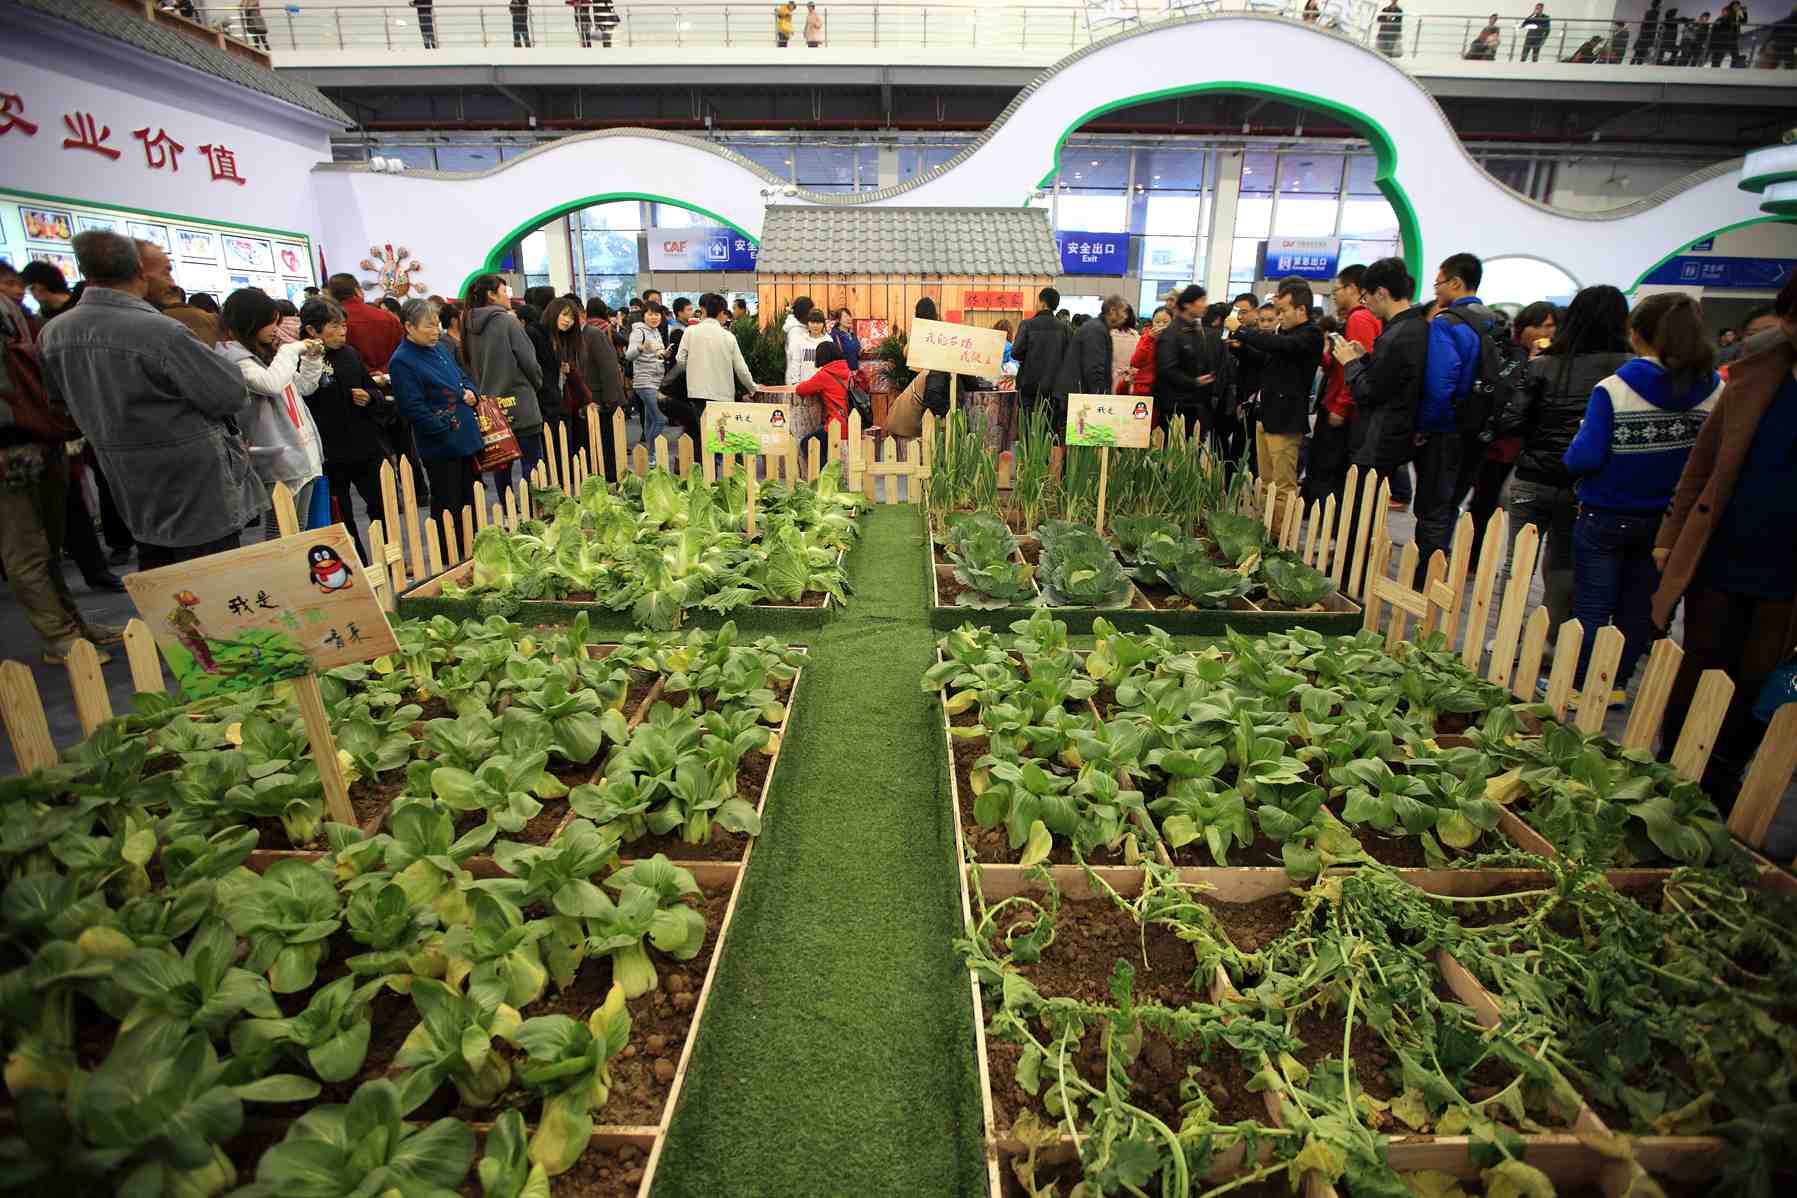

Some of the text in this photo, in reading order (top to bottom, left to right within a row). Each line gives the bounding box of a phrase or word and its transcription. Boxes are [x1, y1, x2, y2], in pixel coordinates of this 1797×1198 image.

[663, 240, 688, 252] CAF
[1067, 242, 1115, 254] 安全出口
[1082, 254, 1098, 263] Exit
[228, 589, 280, 617] 我是
